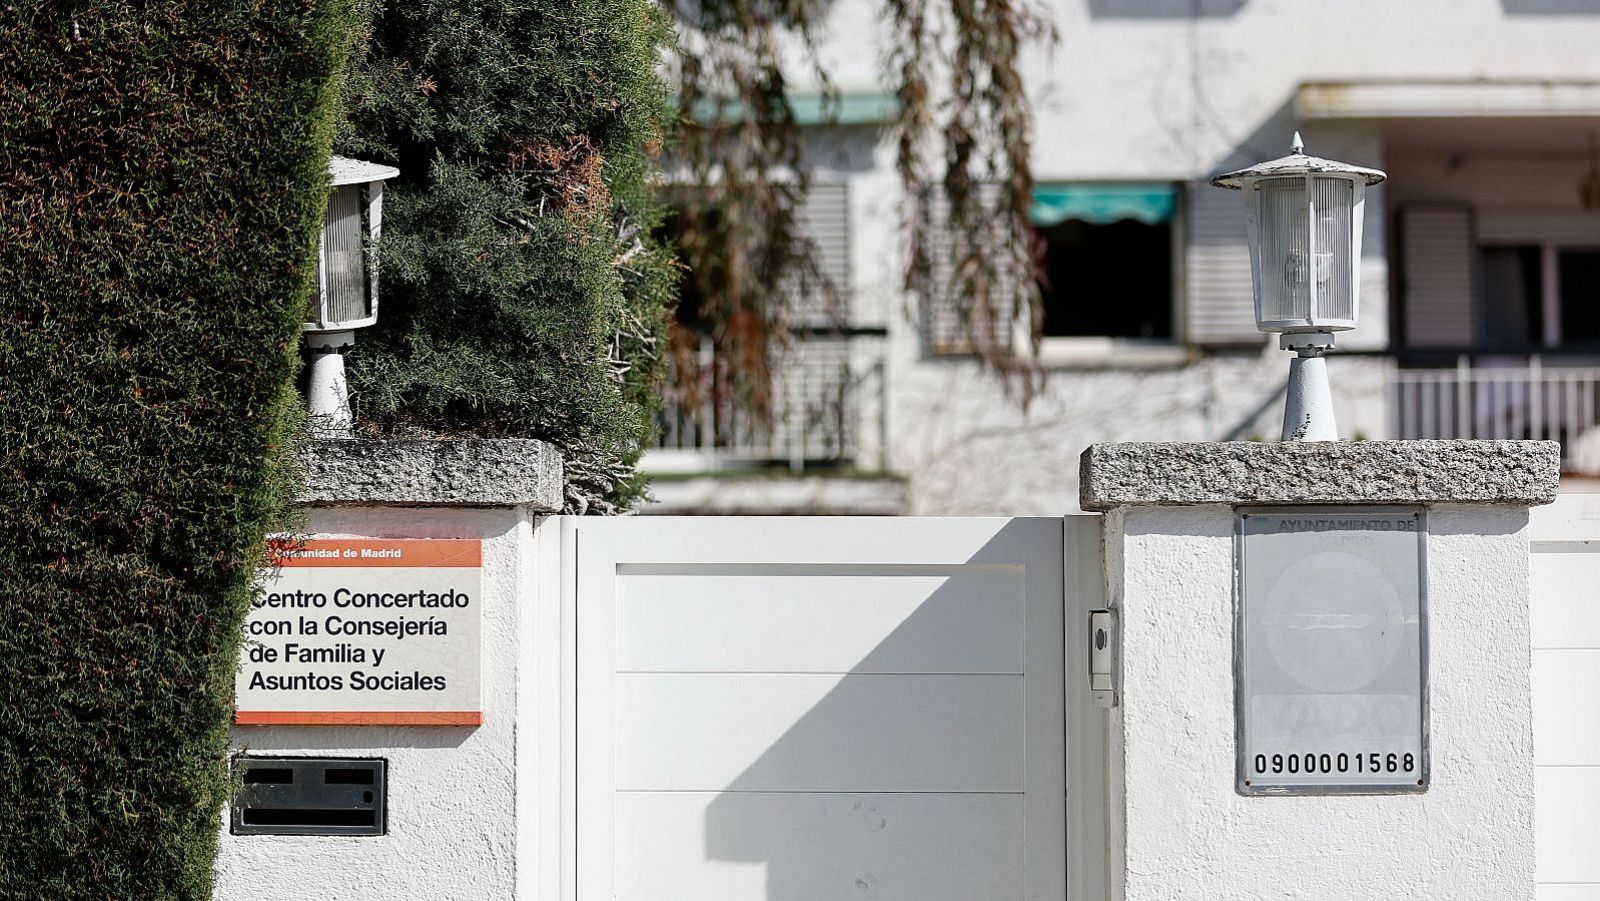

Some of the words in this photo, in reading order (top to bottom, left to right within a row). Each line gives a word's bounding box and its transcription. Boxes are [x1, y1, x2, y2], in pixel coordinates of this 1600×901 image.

[1279, 520, 1391, 531] AYUNTAMIENTO
[1397, 520, 1413, 531] DE
[343, 549, 357, 558] de
[361, 549, 401, 558] Madrid
[333, 588, 469, 608] Concertado
[249, 620, 291, 635] con
[299, 616, 318, 635] la
[325, 616, 447, 639] Consejería
[249, 644, 278, 663] de
[285, 644, 365, 663] Familia
[372, 649, 385, 666] y
[249, 671, 343, 690] Asuntos
[350, 671, 446, 690] Sociales
[1255, 753, 1414, 773] 0900001568
